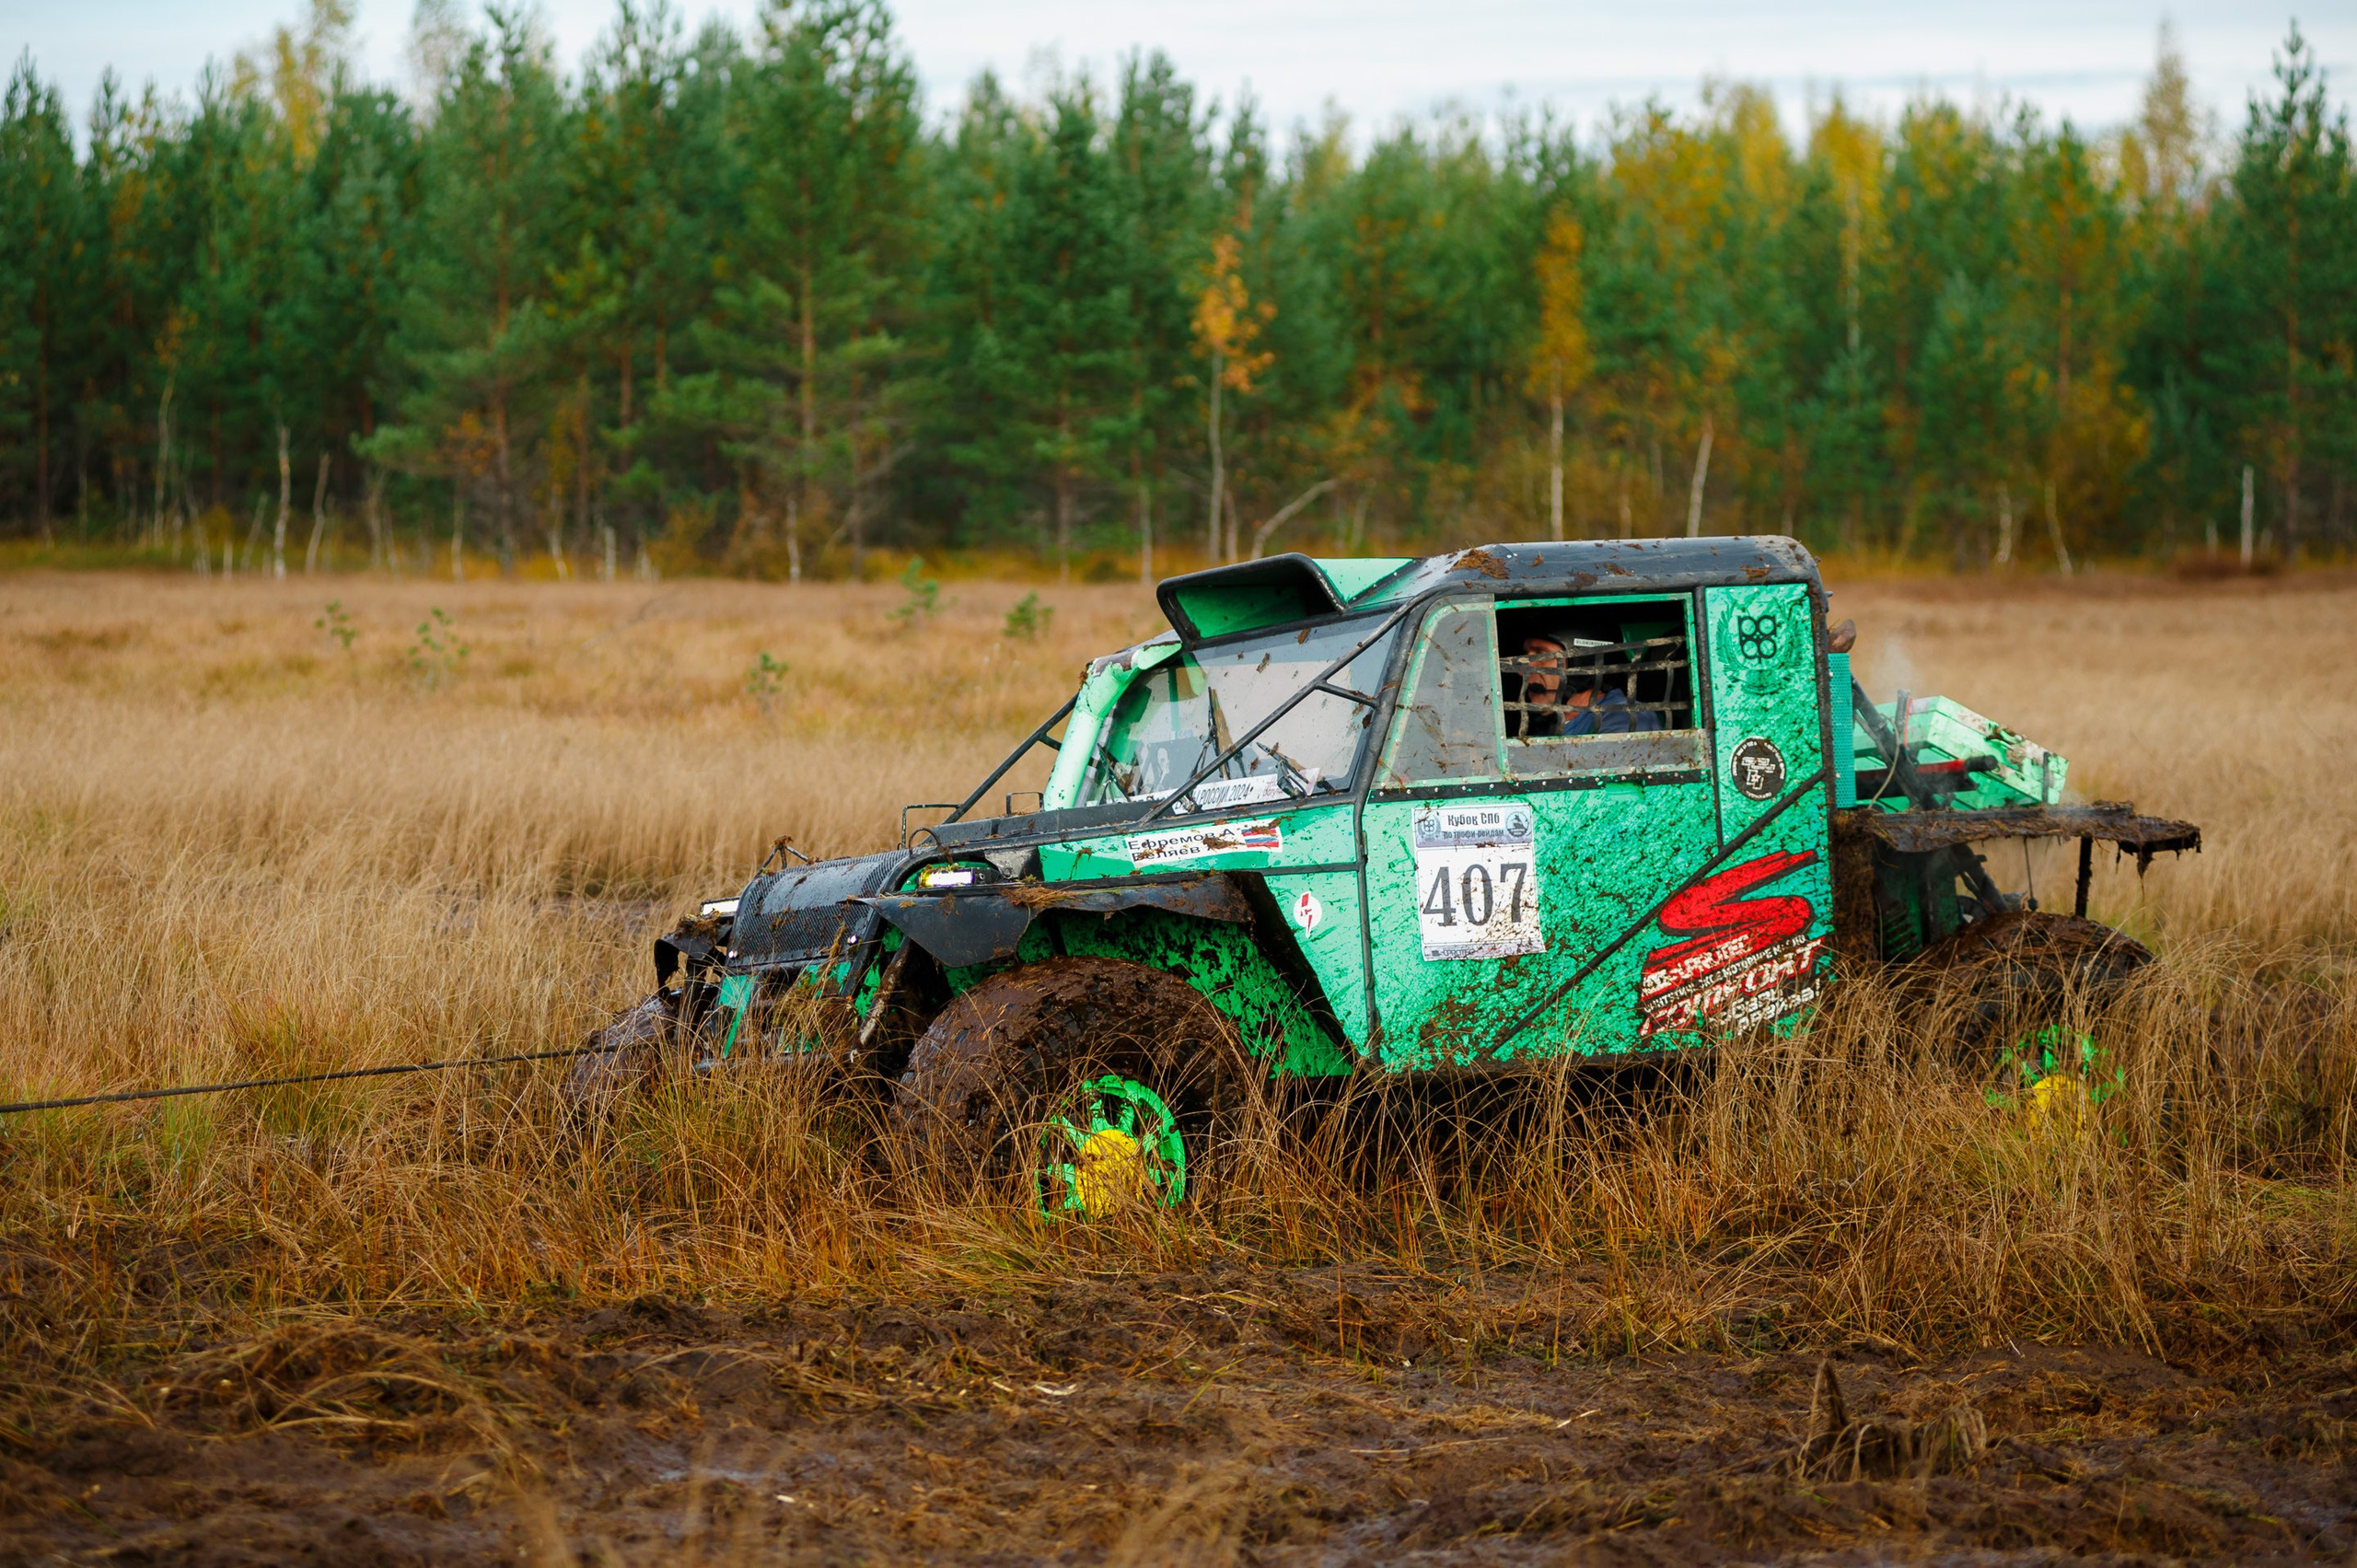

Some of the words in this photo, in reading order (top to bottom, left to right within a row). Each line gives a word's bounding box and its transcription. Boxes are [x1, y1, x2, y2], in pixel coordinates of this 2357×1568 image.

[1447, 814, 1479, 827] Кубок
[1480, 812, 1500, 825] СПб
[1128, 832, 1215, 852] Ефремов
[1222, 828, 1236, 837] А
[1443, 830, 1453, 840] по
[1453, 829, 1504, 840] трофи-рейдам
[1422, 862, 1527, 927] 407
